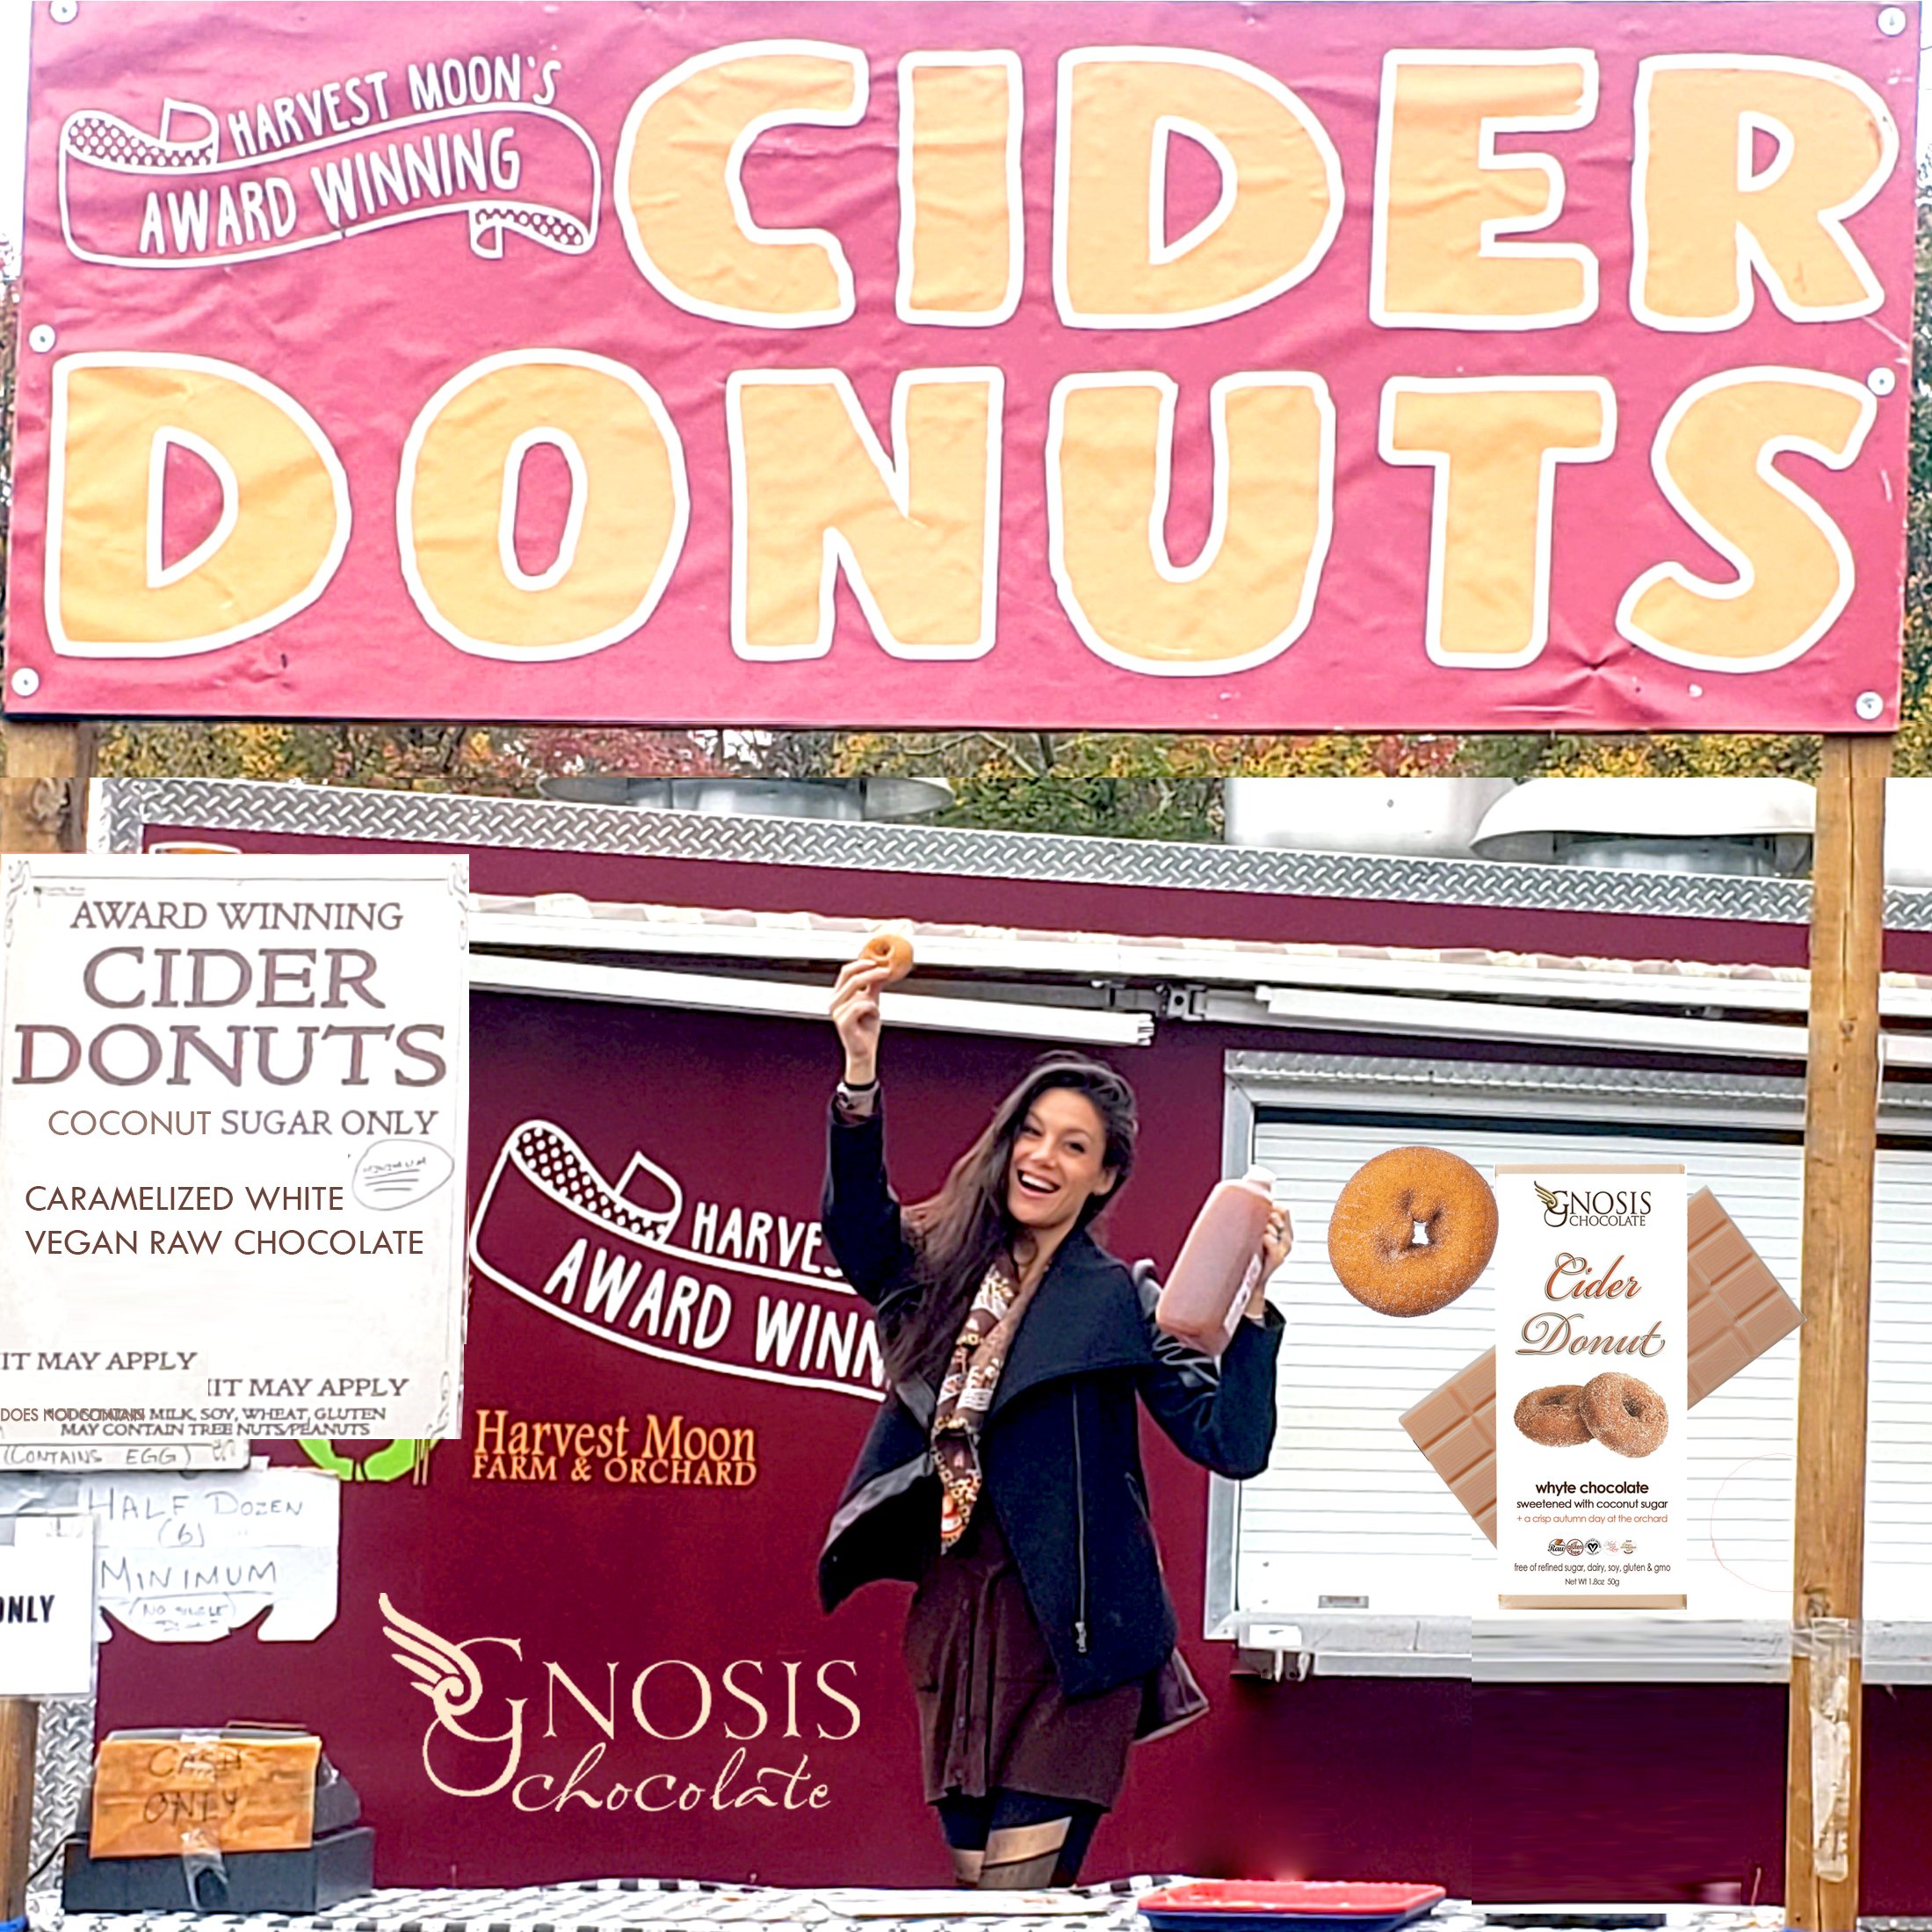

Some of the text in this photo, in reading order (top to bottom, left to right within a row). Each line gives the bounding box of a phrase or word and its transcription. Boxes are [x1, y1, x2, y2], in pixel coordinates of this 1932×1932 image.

[139, 127, 520, 255] AWARD WINNING
[228, 39, 1900, 334] HARVEST MOON'S CIDER
[44, 349, 1878, 677] DONUTS
[70, 901, 403, 930] AWARD WINNING
[83, 946, 386, 1009] CIDER
[12, 1024, 446, 1087] DONUTS
[48, 1110, 438, 1135] COCONUT SUGAR ONLY
[25, 1186, 343, 1211] CARAMELIZED WHITE
[1544, 1190, 1652, 1227] GNOSIS
[1569, 1215, 1646, 1226] CHOCOLATE
[25, 1230, 423, 1255] VEGAN RAW CHOCOLATE
[691, 1202, 844, 1277] HARVE
[1545, 1252, 1642, 1301] Cider
[542, 1238, 732, 1350] AWARD
[1515, 1312, 1666, 1357] Donut
[37, 1352, 101, 1371] MAY
[105, 1351, 198, 1371] APPLY
[249, 1378, 313, 1397] MAY
[317, 1378, 409, 1397] APPLY
[1, 1408, 39, 1422] DOES
[149, 1408, 197, 1421] MILK,
[200, 1407, 238, 1422] SOY,
[315, 1407, 386, 1420] GLUTEN
[61, 1422, 370, 1436] MAY CONTAIN TREE NUTS/PEANUTS
[474, 1409, 756, 1462] Harvest Moon
[472, 1456, 756, 1487] FARM & ORCHARD
[1536, 1481, 1649, 1496] whyte chocolate
[89, 1487, 306, 1522] HALF DOZEN
[1516, 1499, 1668, 1510] sweetened with coconut sugar
[1532, 1515, 1552, 1524] crisp
[1589, 1514, 1606, 1524] day
[1618, 1514, 1633, 1523] the
[1634, 1514, 1668, 1523] orchard
[100, 1556, 278, 1593] MINIMUM
[1514, 1563, 1529, 1572] free
[1530, 1562, 1538, 1572] of
[1538, 1563, 1564, 1572] refined
[1565, 1564, 1586, 1574] sugar,
[1587, 1563, 1607, 1574] dairy,
[1608, 1565, 1622, 1574] soy,
[1624, 1563, 1646, 1574] gluten
[1654, 1565, 1671, 1574] gmo
[1607, 1578, 1620, 1587] 50g
[0, 1595, 55, 1624] NLY
[143, 1788, 238, 1826] ONLY
